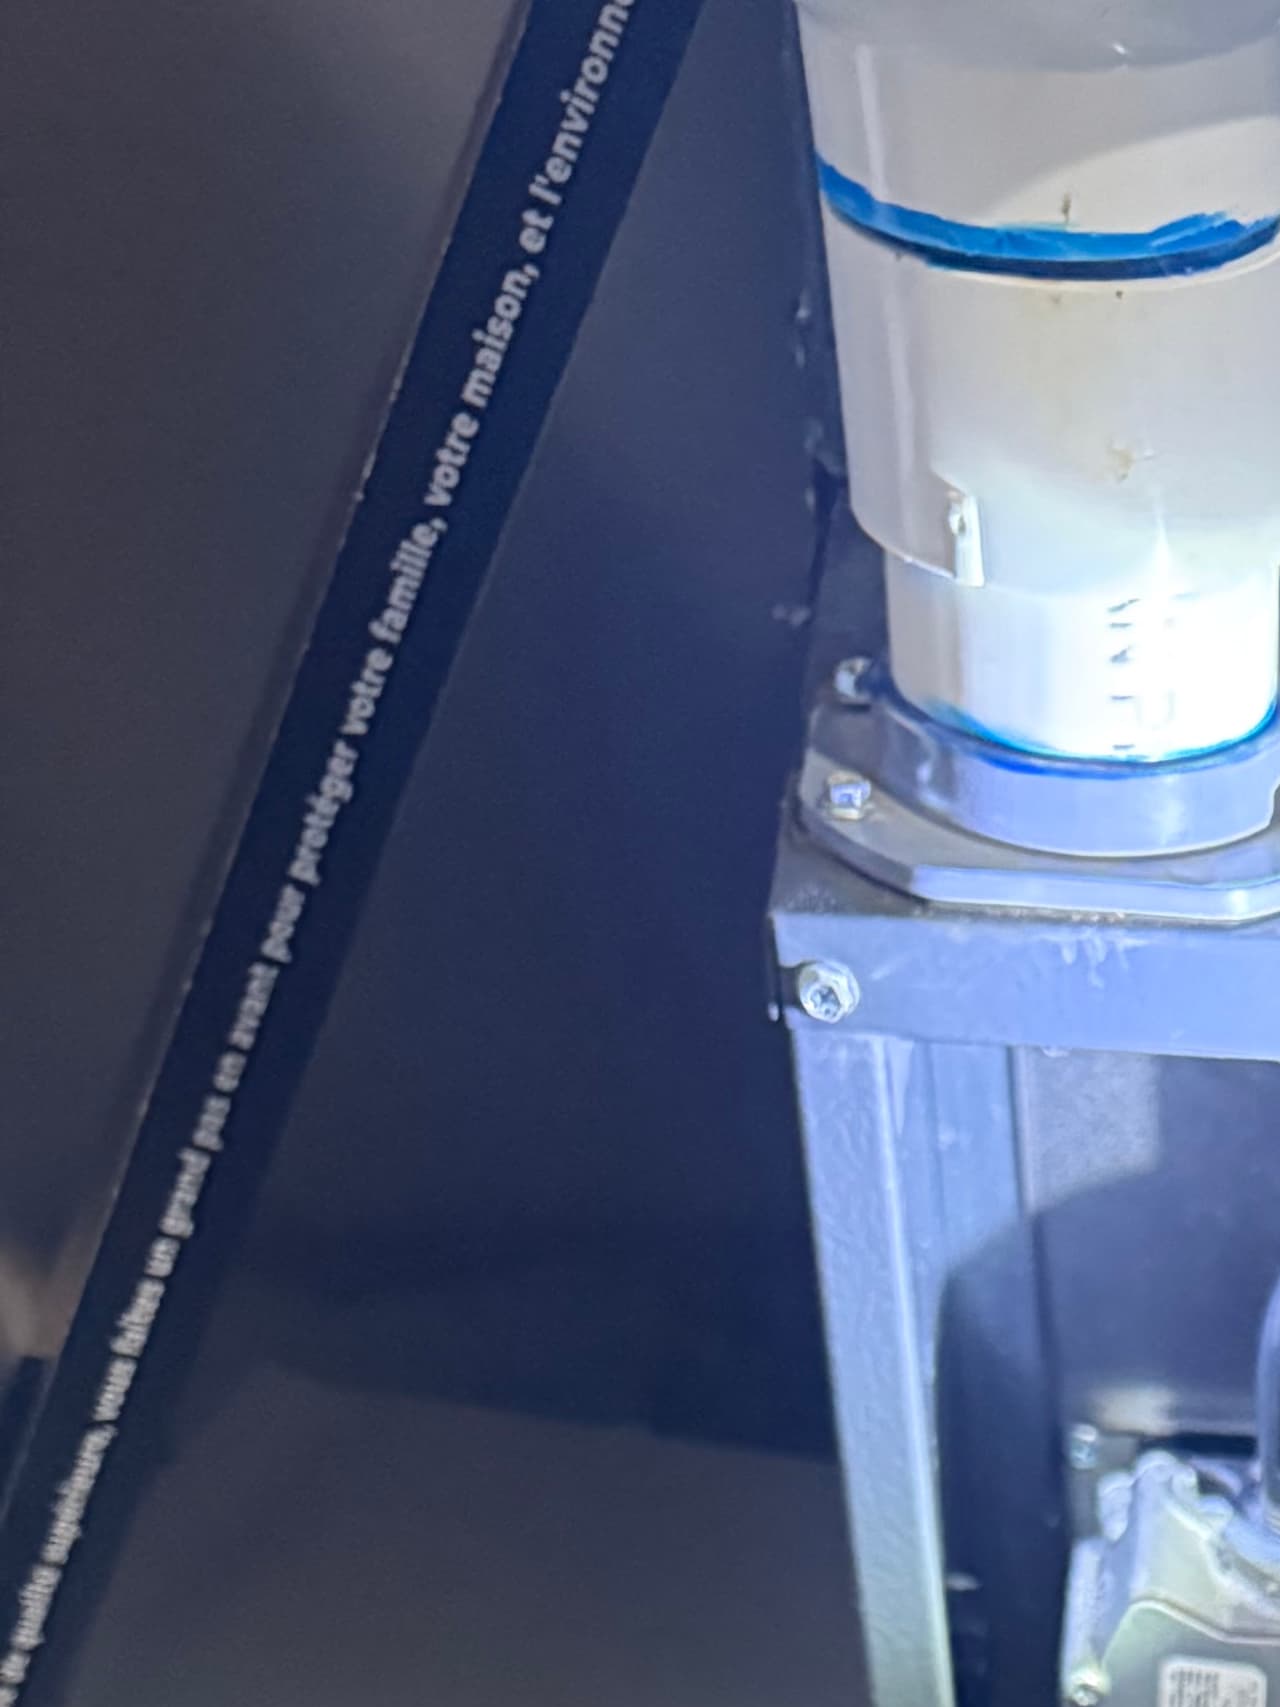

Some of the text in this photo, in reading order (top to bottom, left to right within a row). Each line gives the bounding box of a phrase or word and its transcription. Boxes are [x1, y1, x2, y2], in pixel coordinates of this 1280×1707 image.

[527, 0, 636, 207] l'environn
[518, 208, 555, 255] et
[460, 263, 541, 409] maison,
[423, 411, 481, 507] votre
[368, 517, 449, 644] famille,
[340, 647, 394, 736] votre
[287, 738, 359, 887] protéger
[259, 882, 306, 964] pour
[228, 962, 280, 1051] avant
[212, 1050, 248, 1093] en
[192, 1095, 232, 1152] pas
[158, 1147, 212, 1240] grand
[143, 1235, 180, 1278] un
[109, 1276, 166, 1357] faites
[92, 1356, 138, 1422] vous
